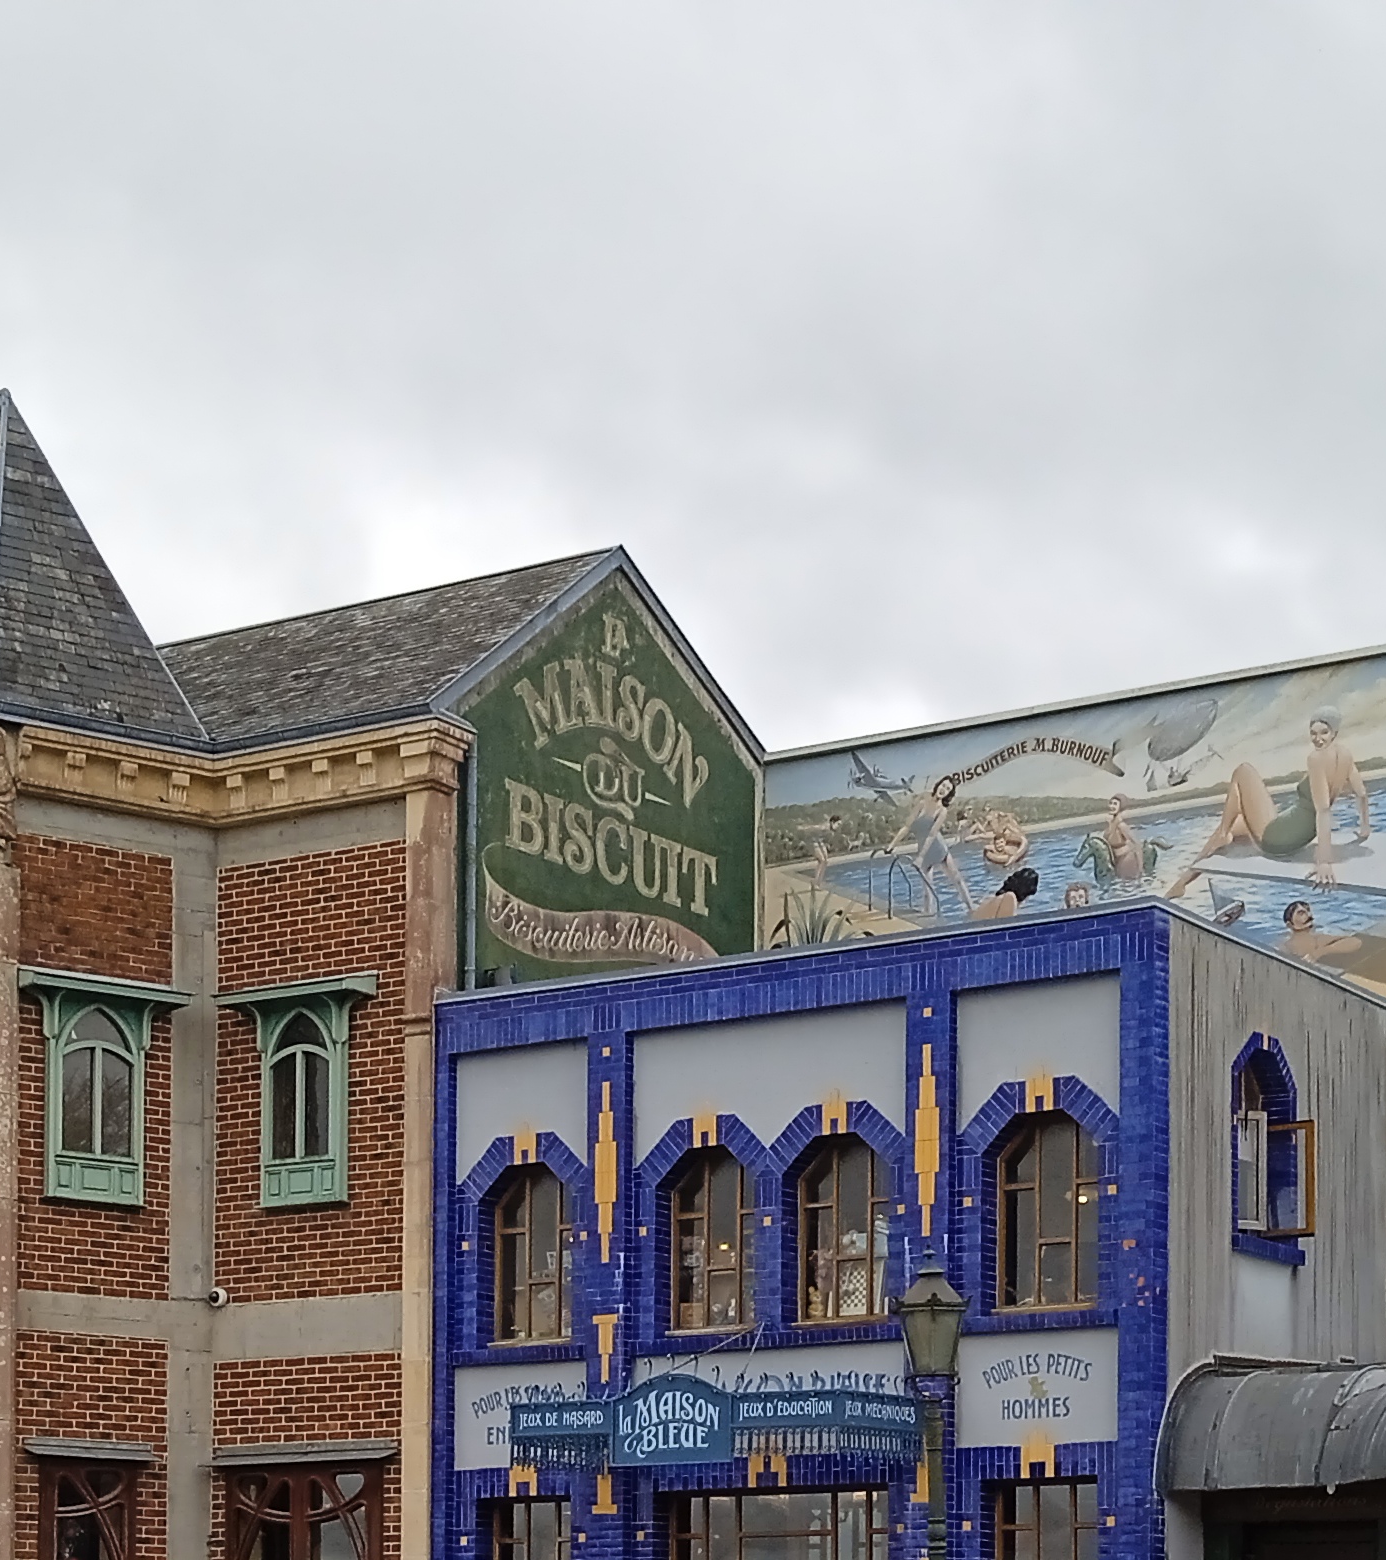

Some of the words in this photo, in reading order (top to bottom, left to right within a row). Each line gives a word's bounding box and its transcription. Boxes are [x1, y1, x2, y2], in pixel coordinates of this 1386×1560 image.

[513, 660, 710, 809] MAISON
[582, 737, 646, 821] DU
[951, 740, 1028, 787] BISCUITERIE
[505, 777, 718, 917] BISCUIT
[490, 900, 612, 953] Biscuiterie
[612, 916, 703, 961] Artisan
[982, 1359, 1019, 1389] POUR
[1019, 1353, 1040, 1376] LES
[1046, 1353, 1093, 1382] PETITS
[471, 1391, 504, 1419] POUR
[519, 1412, 543, 1430] JEUX
[545, 1412, 558, 1427] DE
[630, 1389, 720, 1438] MAISON
[738, 1401, 764, 1422] JEUX
[844, 1400, 862, 1420] JEUX
[1001, 1396, 1071, 1420] HOMMES
[637, 1425, 710, 1459] BLEUE
